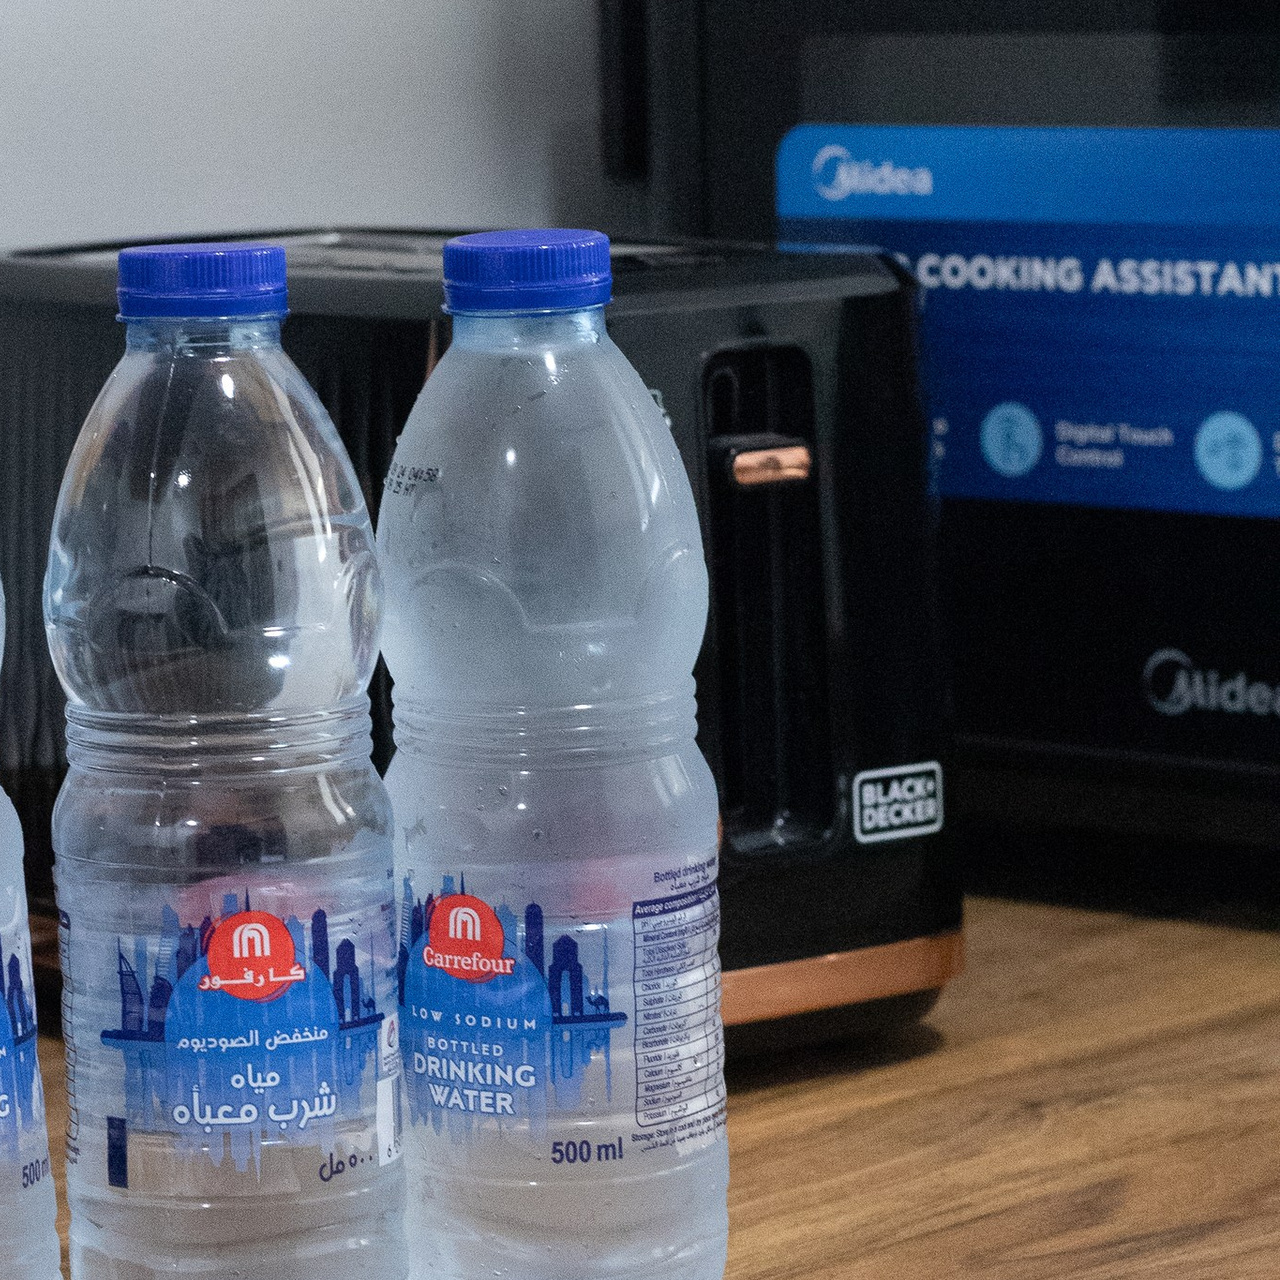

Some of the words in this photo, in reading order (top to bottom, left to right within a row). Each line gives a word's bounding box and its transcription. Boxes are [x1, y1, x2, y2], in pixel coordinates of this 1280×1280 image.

[814, 146, 932, 200] Midea
[917, 252, 1085, 294] COOKING
[422, 945, 516, 975] Carrefour
[411, 1004, 443, 1022] LOW
[455, 1013, 537, 1030] SODIUM
[176, 1028, 260, 1053] الصوديوم
[264, 1025, 329, 1051] منخفض
[427, 1036, 504, 1057] BOTTLED
[230, 1062, 281, 1094] مياه
[413, 1051, 536, 1088] DRINKING
[268, 1080, 337, 1130] شرب
[428, 1083, 516, 1115] WATER
[551, 1139, 592, 1165] 500
[596, 1135, 624, 1162] ml
[22, 1158, 41, 1189] 500
